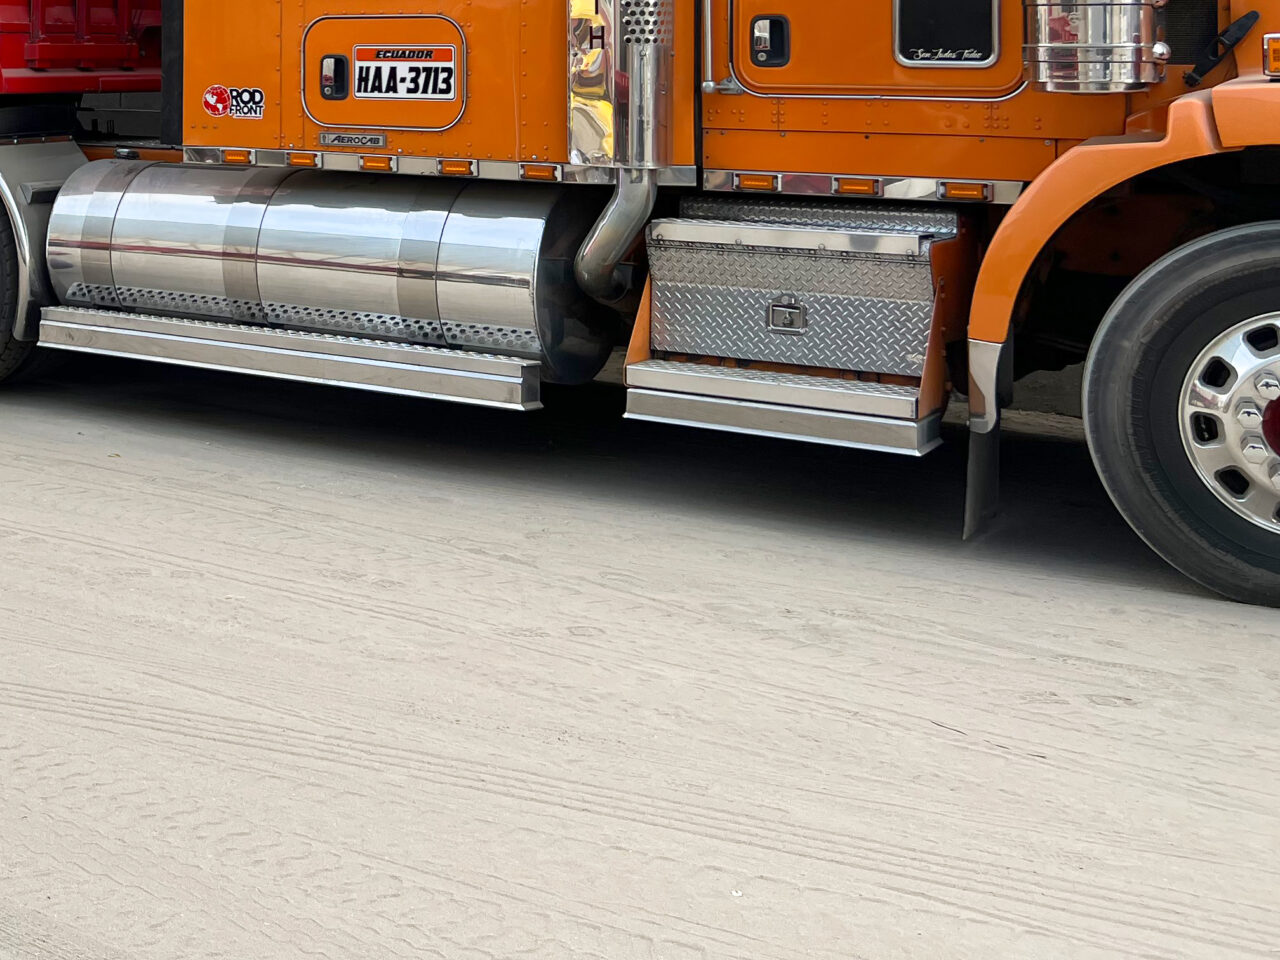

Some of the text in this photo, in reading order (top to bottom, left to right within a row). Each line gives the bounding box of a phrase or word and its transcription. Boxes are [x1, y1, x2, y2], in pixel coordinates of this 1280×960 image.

[375, 50, 433, 59] ECUADOR
[356, 66, 453, 94] HAA-3713
[229, 88, 264, 105] ROD
[229, 105, 264, 116] FRONT
[331, 135, 380, 145] AEROCAB
